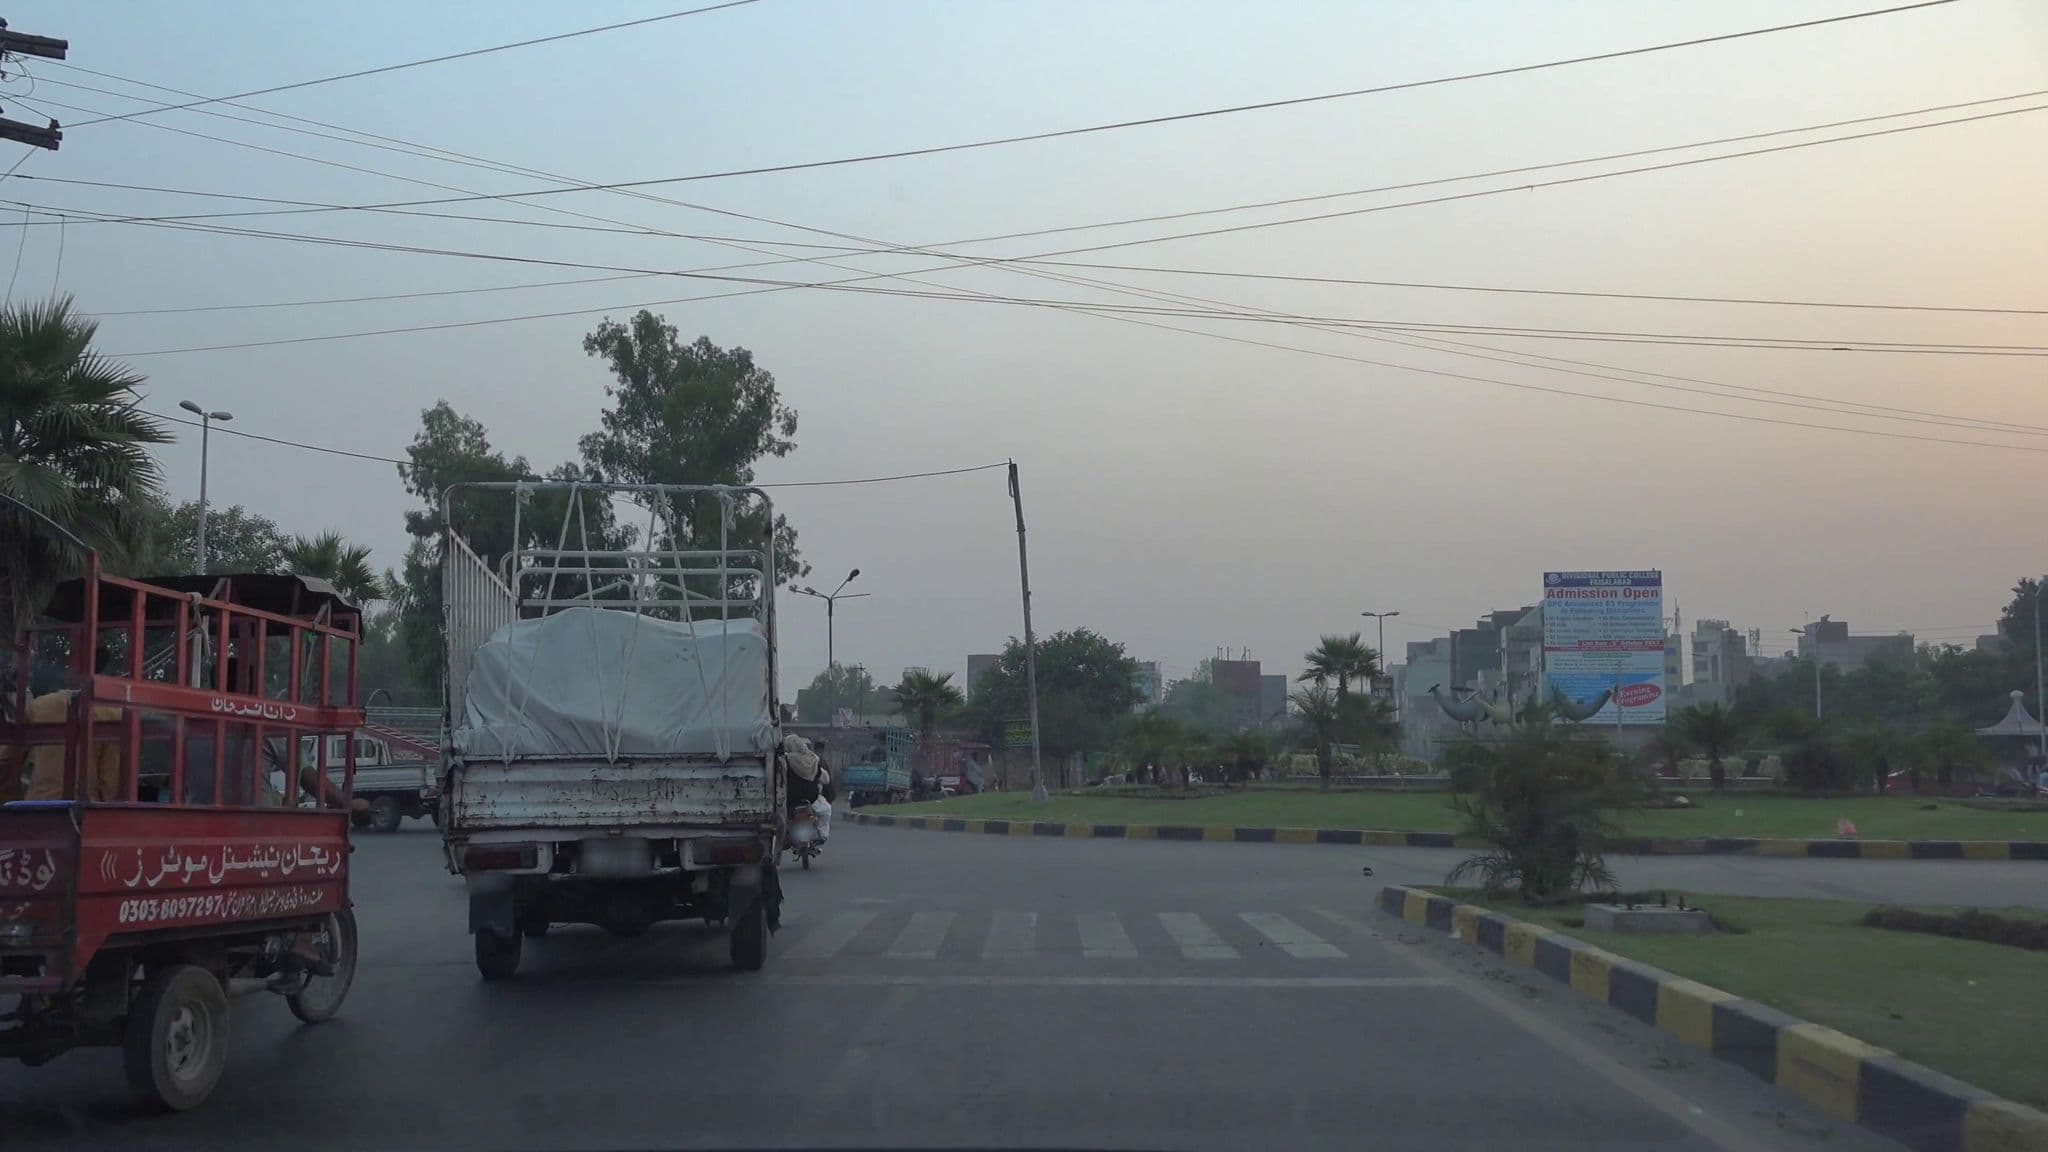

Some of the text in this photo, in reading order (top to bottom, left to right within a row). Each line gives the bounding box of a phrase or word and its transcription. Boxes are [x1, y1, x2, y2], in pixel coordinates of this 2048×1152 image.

[1602, 571, 1627, 579] PUBLIC
[1547, 587, 1659, 600] Admission Open
[208, 843, 281, 884] نیشنل
[281, 842, 341, 876] ریحان
